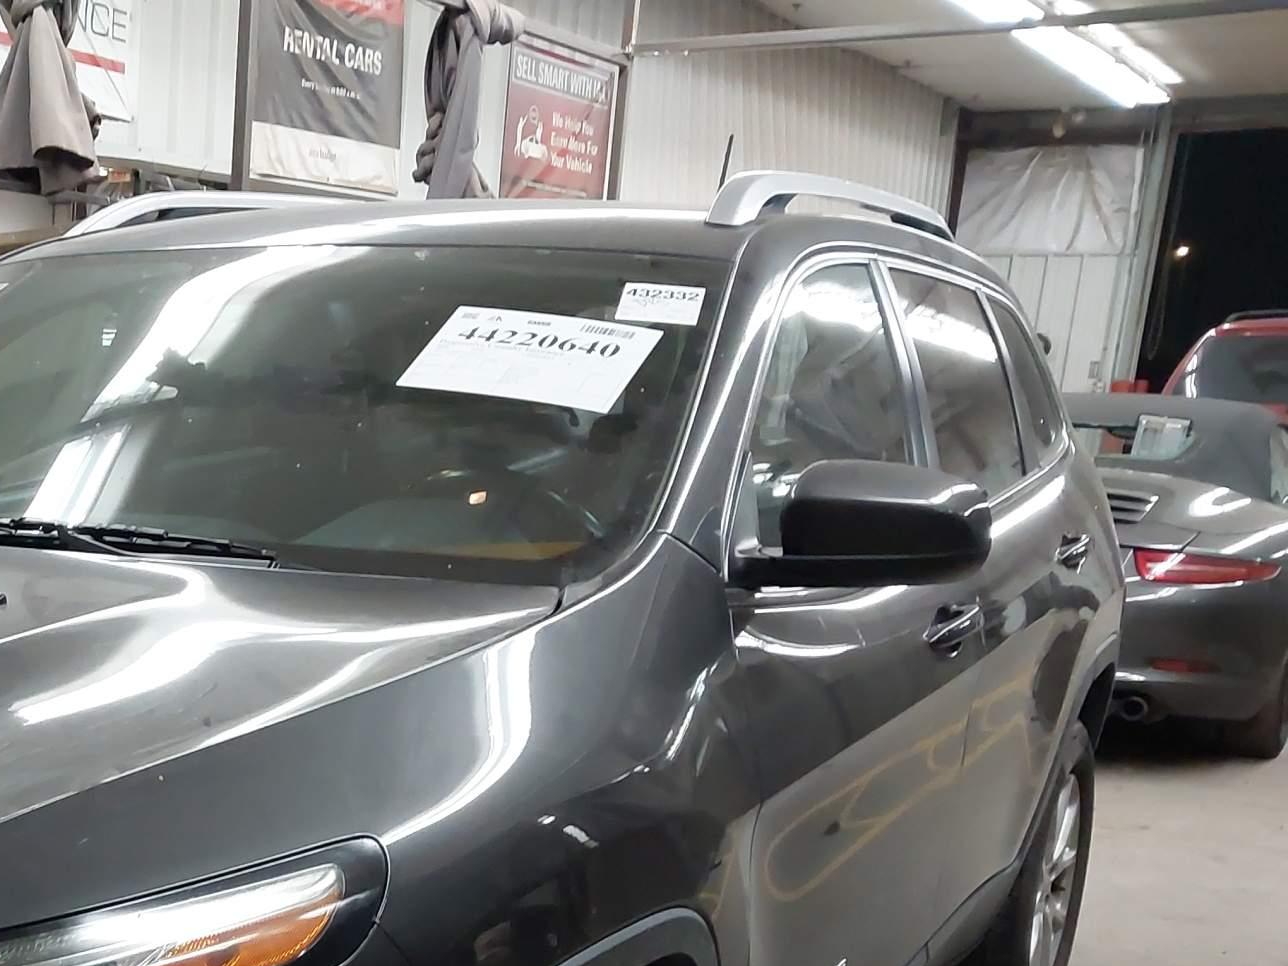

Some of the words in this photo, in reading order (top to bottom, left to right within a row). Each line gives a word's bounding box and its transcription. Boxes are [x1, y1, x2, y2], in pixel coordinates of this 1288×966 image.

[77, 0, 127, 43] NCE
[283, 26, 340, 65] RENTAL
[344, 43, 383, 76] CARS
[516, 55, 537, 81] SELL
[538, 62, 569, 92] SMART
[570, 72, 592, 98] WITH
[566, 154, 593, 175] Vehicle
[626, 288, 700, 302] 432332
[458, 326, 621, 358] 44220640
